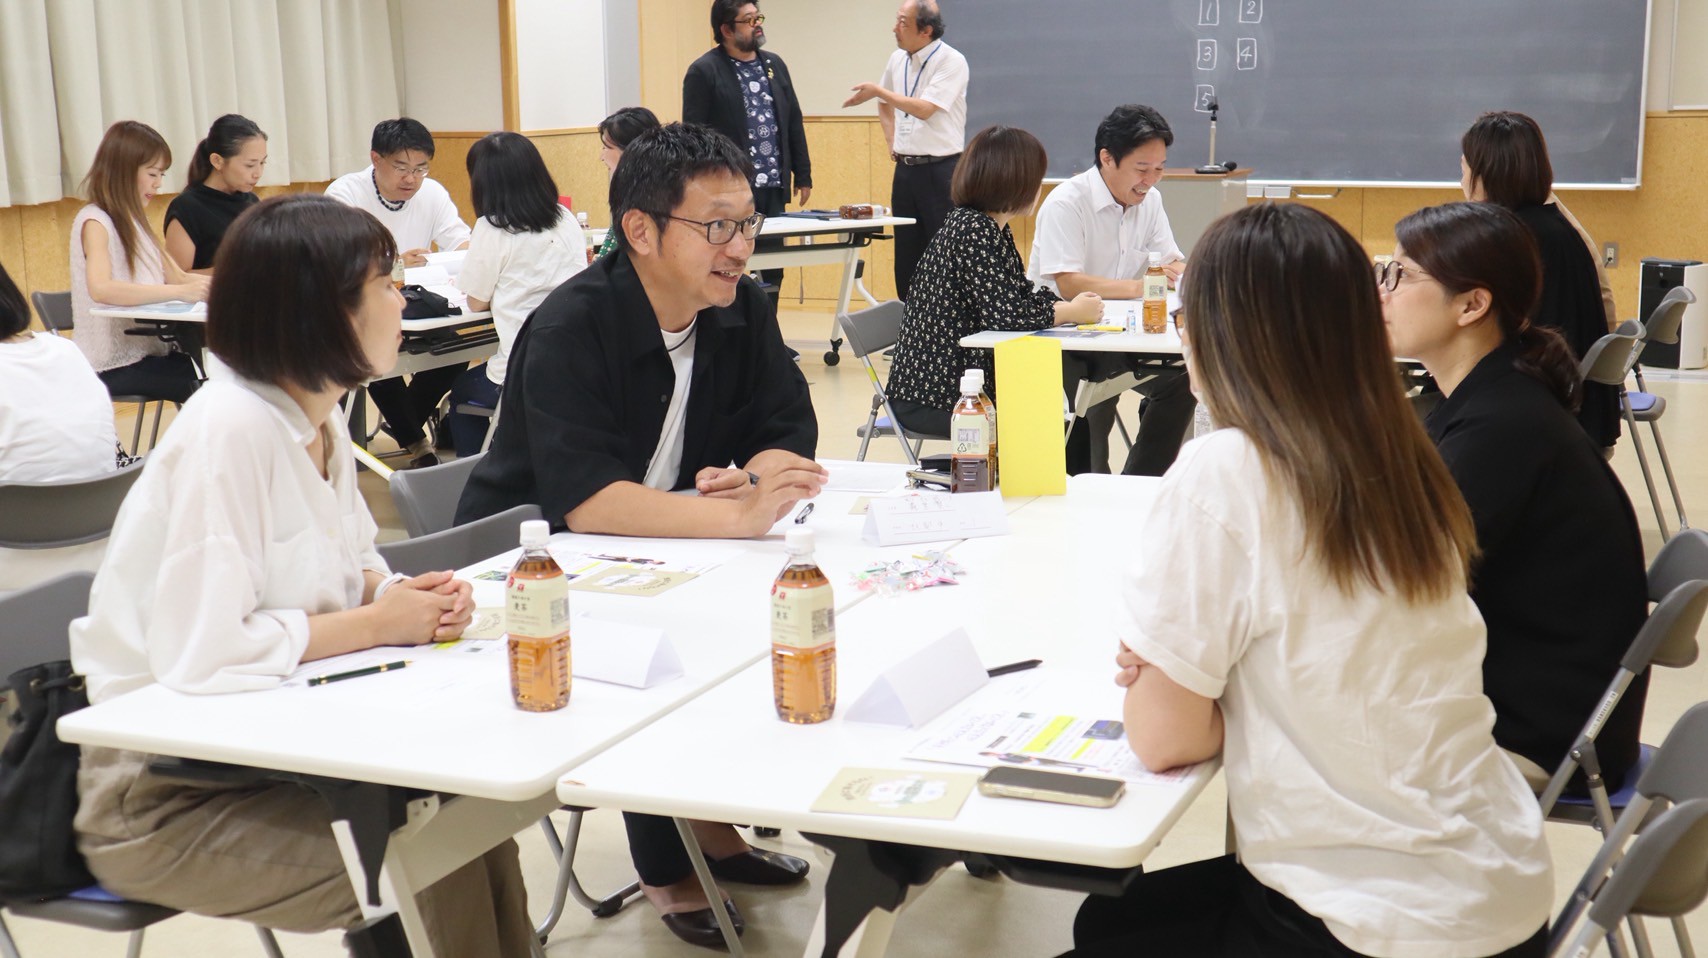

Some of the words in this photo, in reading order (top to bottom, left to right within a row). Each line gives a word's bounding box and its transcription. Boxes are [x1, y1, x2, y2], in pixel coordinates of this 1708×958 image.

[1206, 2, 1212, 21] 1
[1246, 0, 1256, 14] 2
[1203, 46, 1212, 62] 3
[1240, 45, 1252, 62] 4
[1201, 92, 1212, 107] 5
